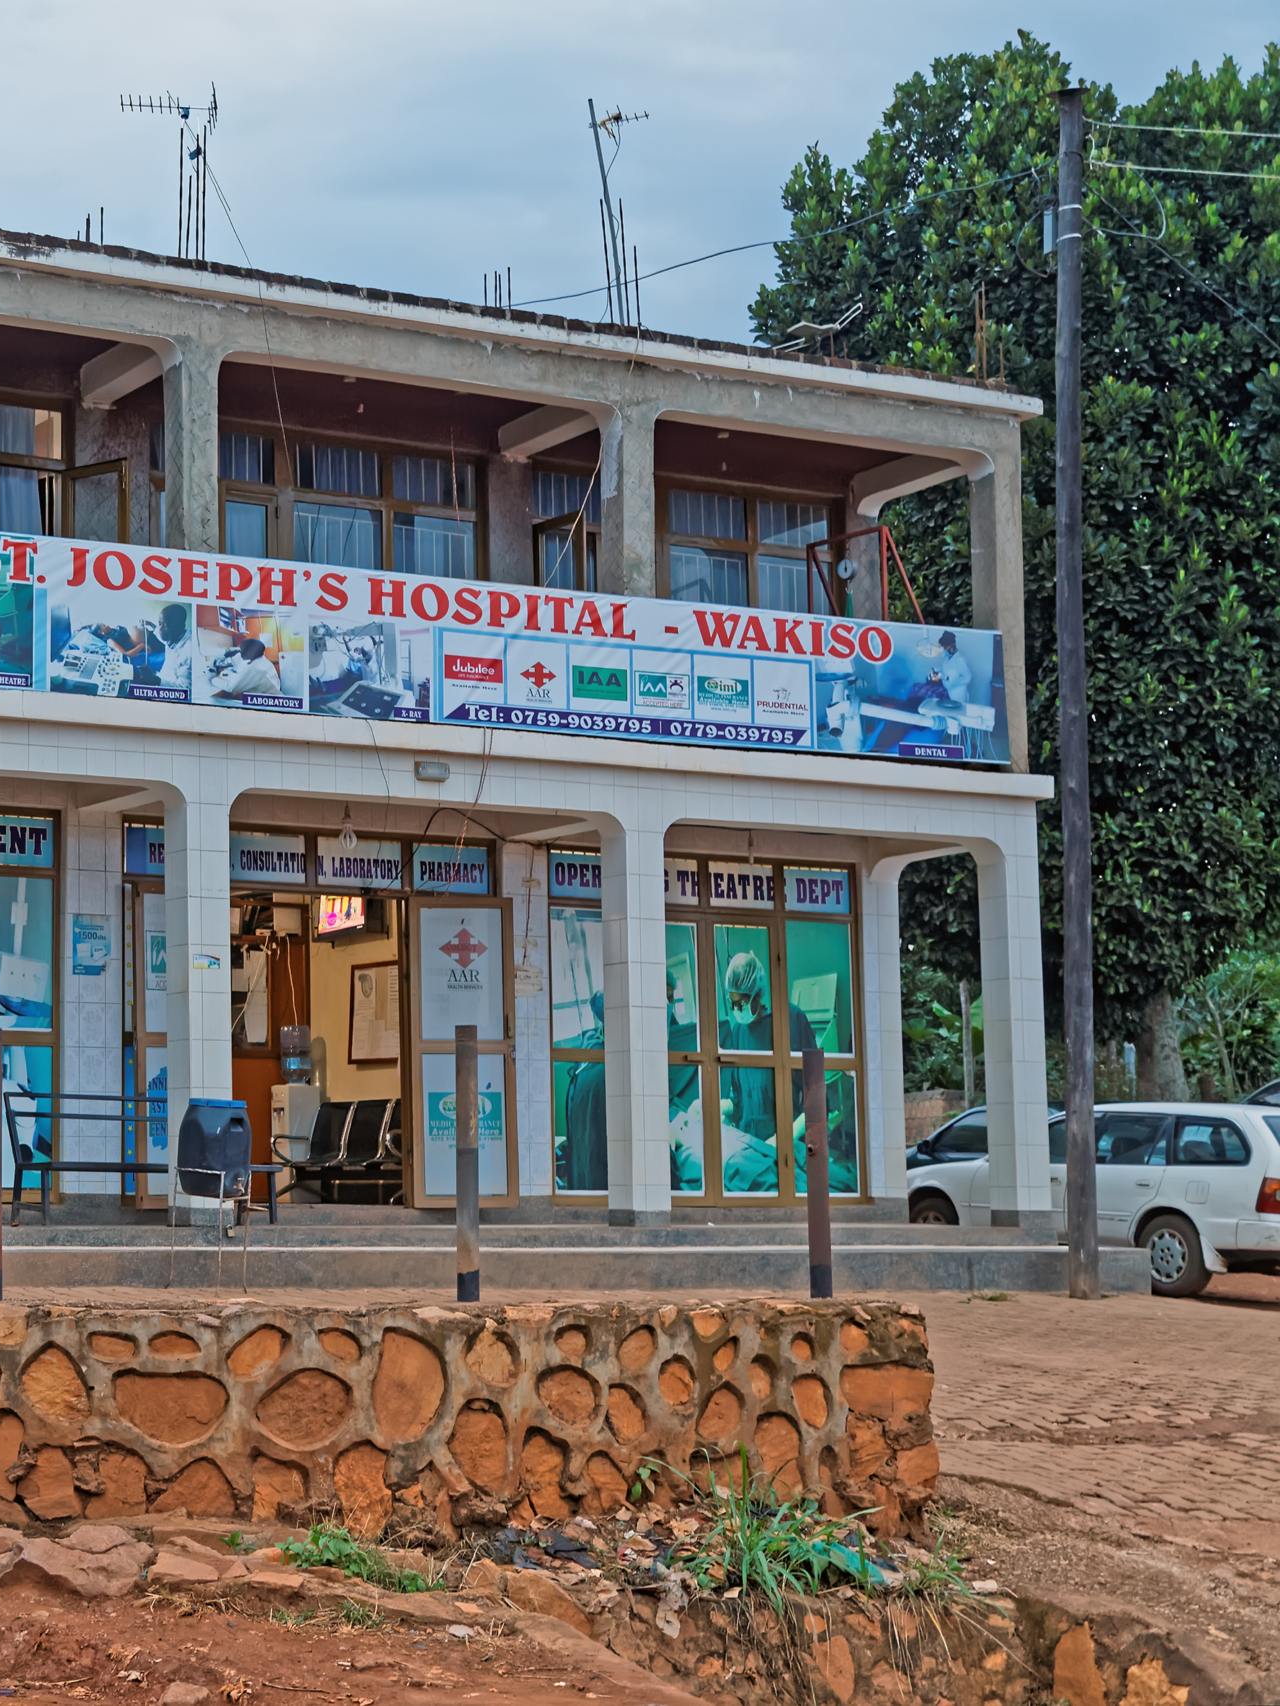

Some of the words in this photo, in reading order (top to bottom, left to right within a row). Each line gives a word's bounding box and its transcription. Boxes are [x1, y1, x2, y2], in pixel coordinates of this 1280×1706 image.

[67, 547, 349, 612] JOSEPH'S
[368, 577, 636, 641] HOSPITAL
[693, 610, 893, 662] WAKISO
[452, 658, 495, 675] Jubilee
[578, 670, 622, 687] IAA
[133, 688, 158, 698] ULTRA
[159, 689, 186, 701] SOUND
[247, 693, 300, 708] LABORATORY
[526, 688, 550, 699] AAR
[642, 700, 669, 708] ACCEPTED
[756, 700, 808, 711] PRUDENTIAL
[465, 704, 504, 722] Tel:
[510, 710, 652, 734] 0759-9039795
[670, 721, 794, 745] 0779-039795
[914, 747, 947, 758] DENTAL
[420, 860, 485, 885] PHARMACY
[796, 877, 844, 906] DEPT
[447, 969, 480, 982] AAR
